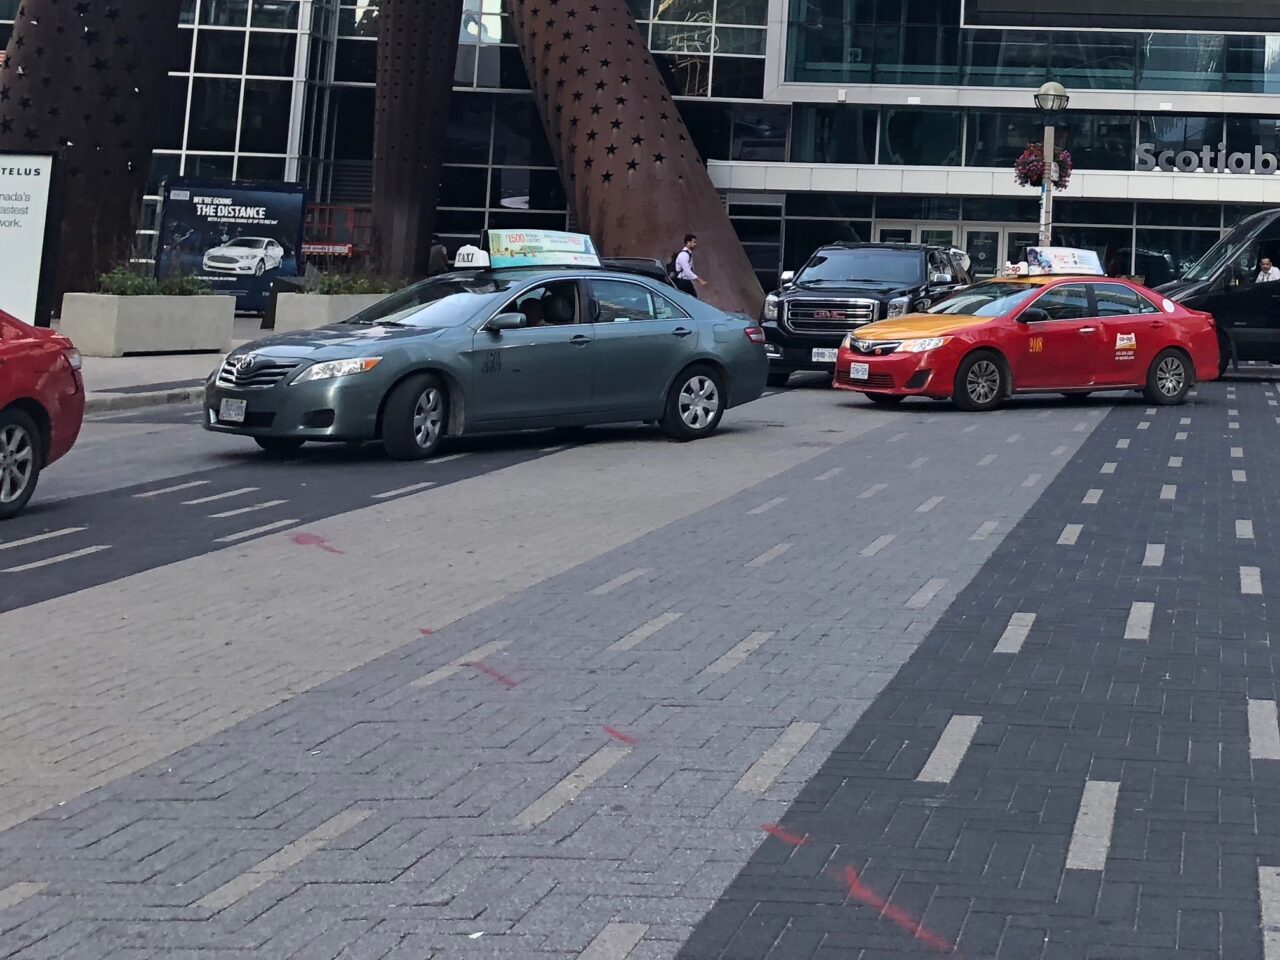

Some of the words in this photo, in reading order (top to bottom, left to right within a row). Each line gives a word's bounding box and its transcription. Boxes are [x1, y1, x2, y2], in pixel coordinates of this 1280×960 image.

[1, 167, 41, 176] TELUS
[193, 196, 213, 204] WE'RE
[213, 197, 233, 205] GOING
[196, 204, 216, 216] THE
[217, 205, 266, 218] DISTANCE
[457, 252, 475, 263] TAXI
[814, 310, 845, 318] GMC
